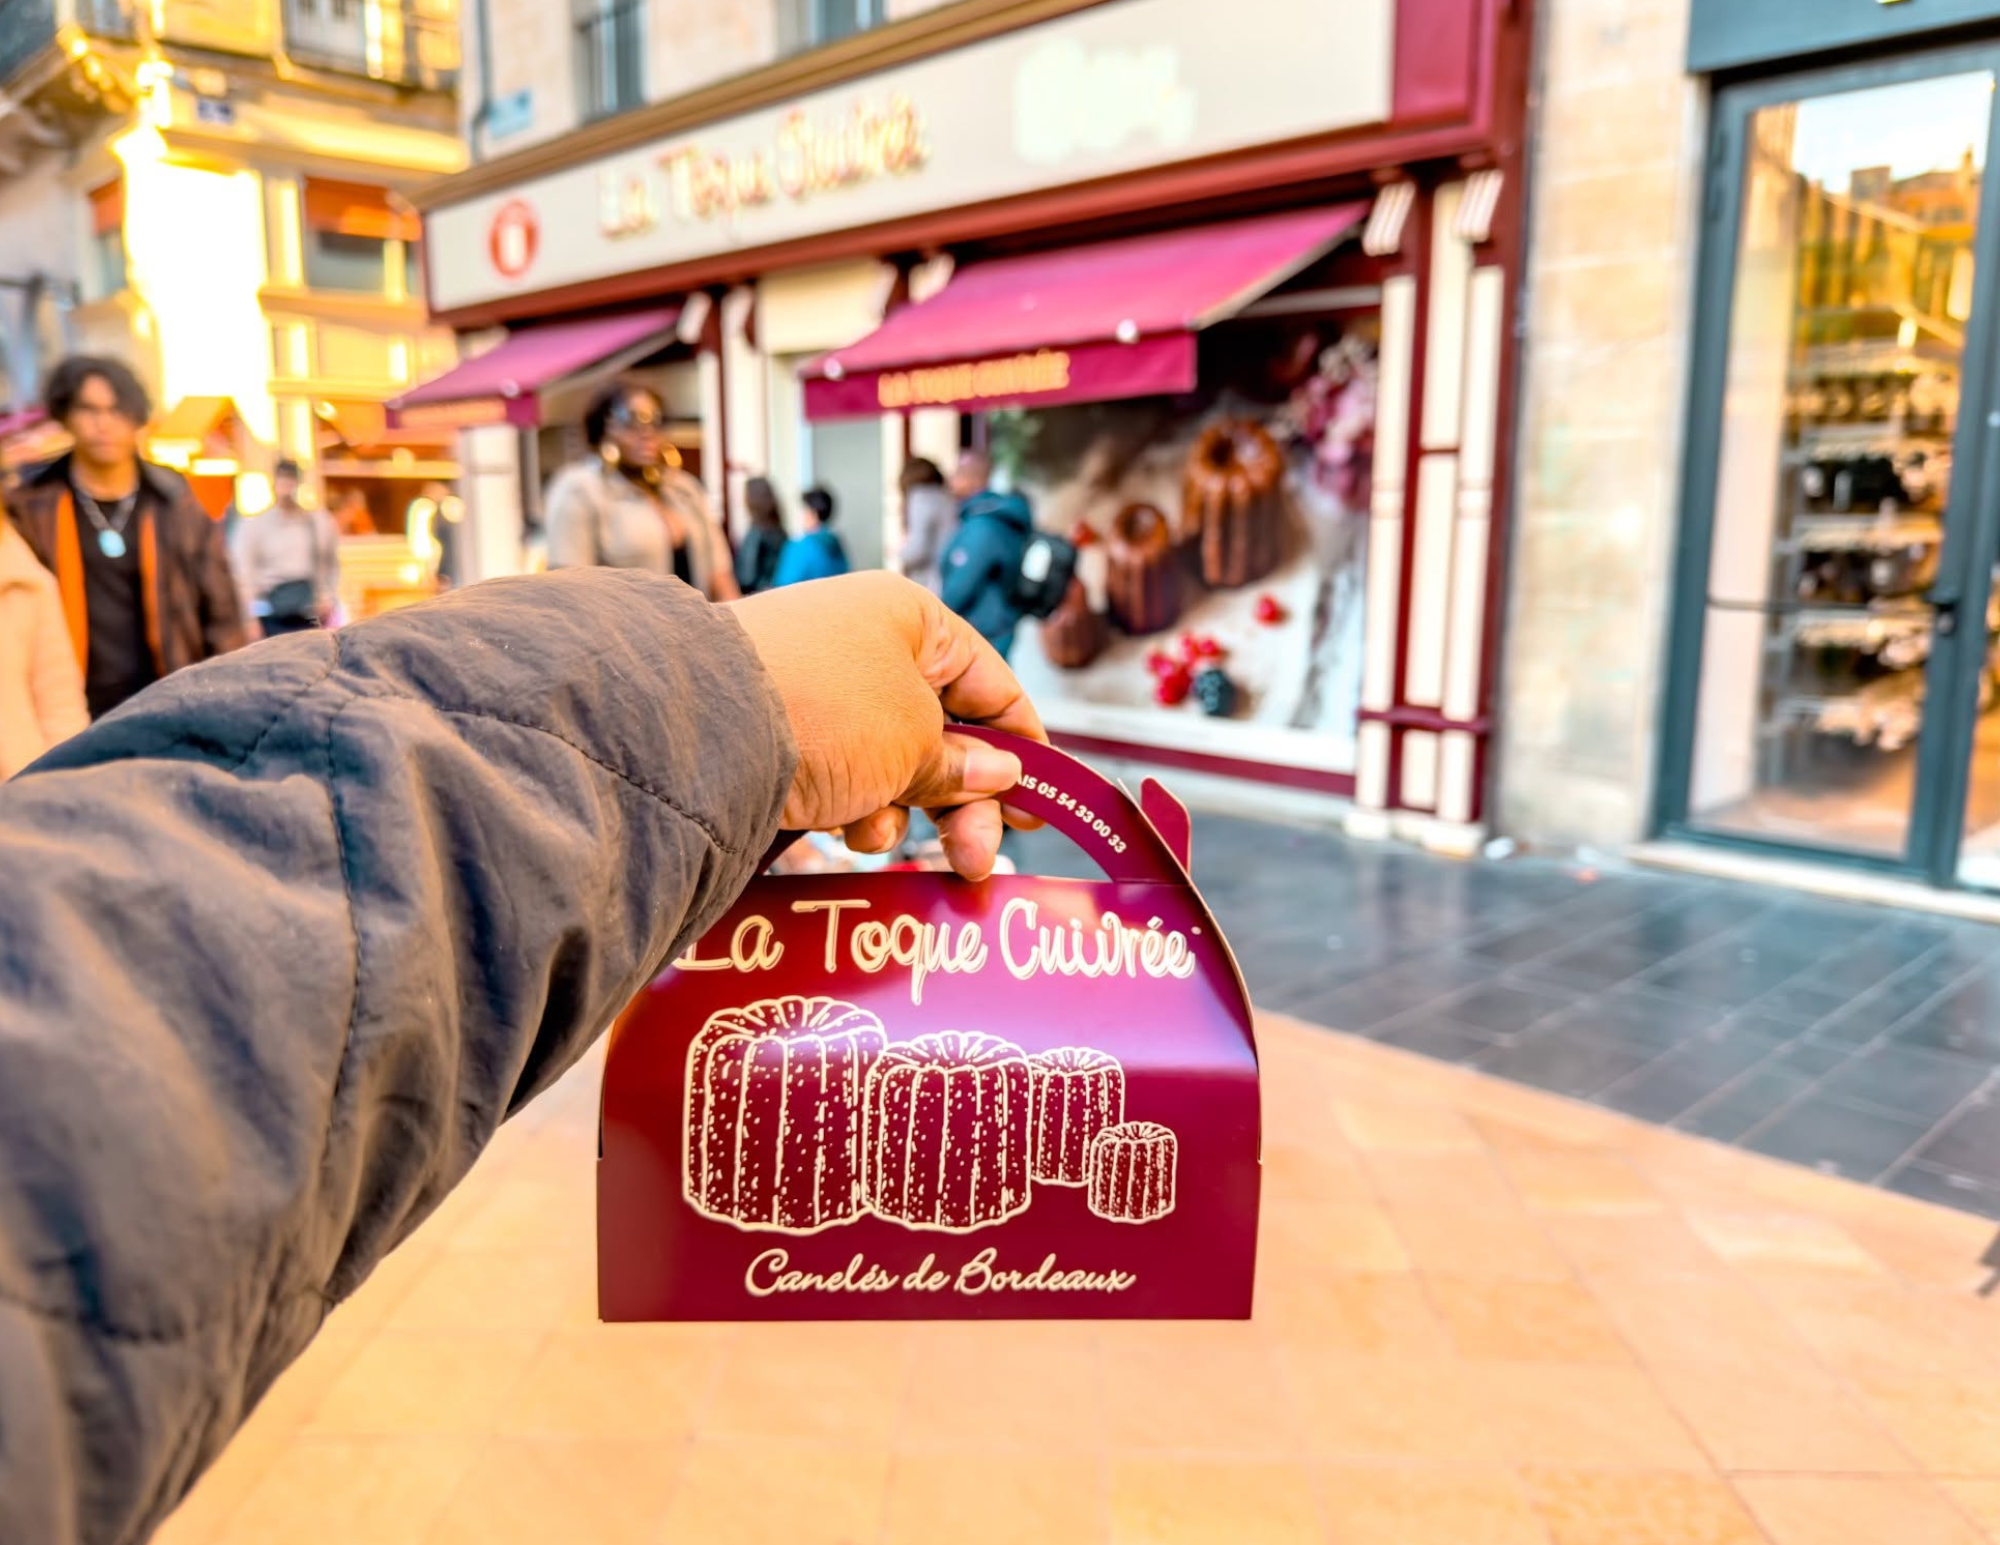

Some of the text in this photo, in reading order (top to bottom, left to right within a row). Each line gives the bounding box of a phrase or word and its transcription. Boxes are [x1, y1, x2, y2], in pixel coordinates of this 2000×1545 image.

[1036, 781, 1058, 800] 05
[1056, 792, 1077, 811] 54
[1074, 804, 1095, 824] 33
[1091, 818, 1112, 838] 00
[1107, 833, 1127, 854] 33
[671, 897, 1197, 1006] La Toque Cuivrée
[744, 1246, 1137, 1297] Canelés de Bordeaux
